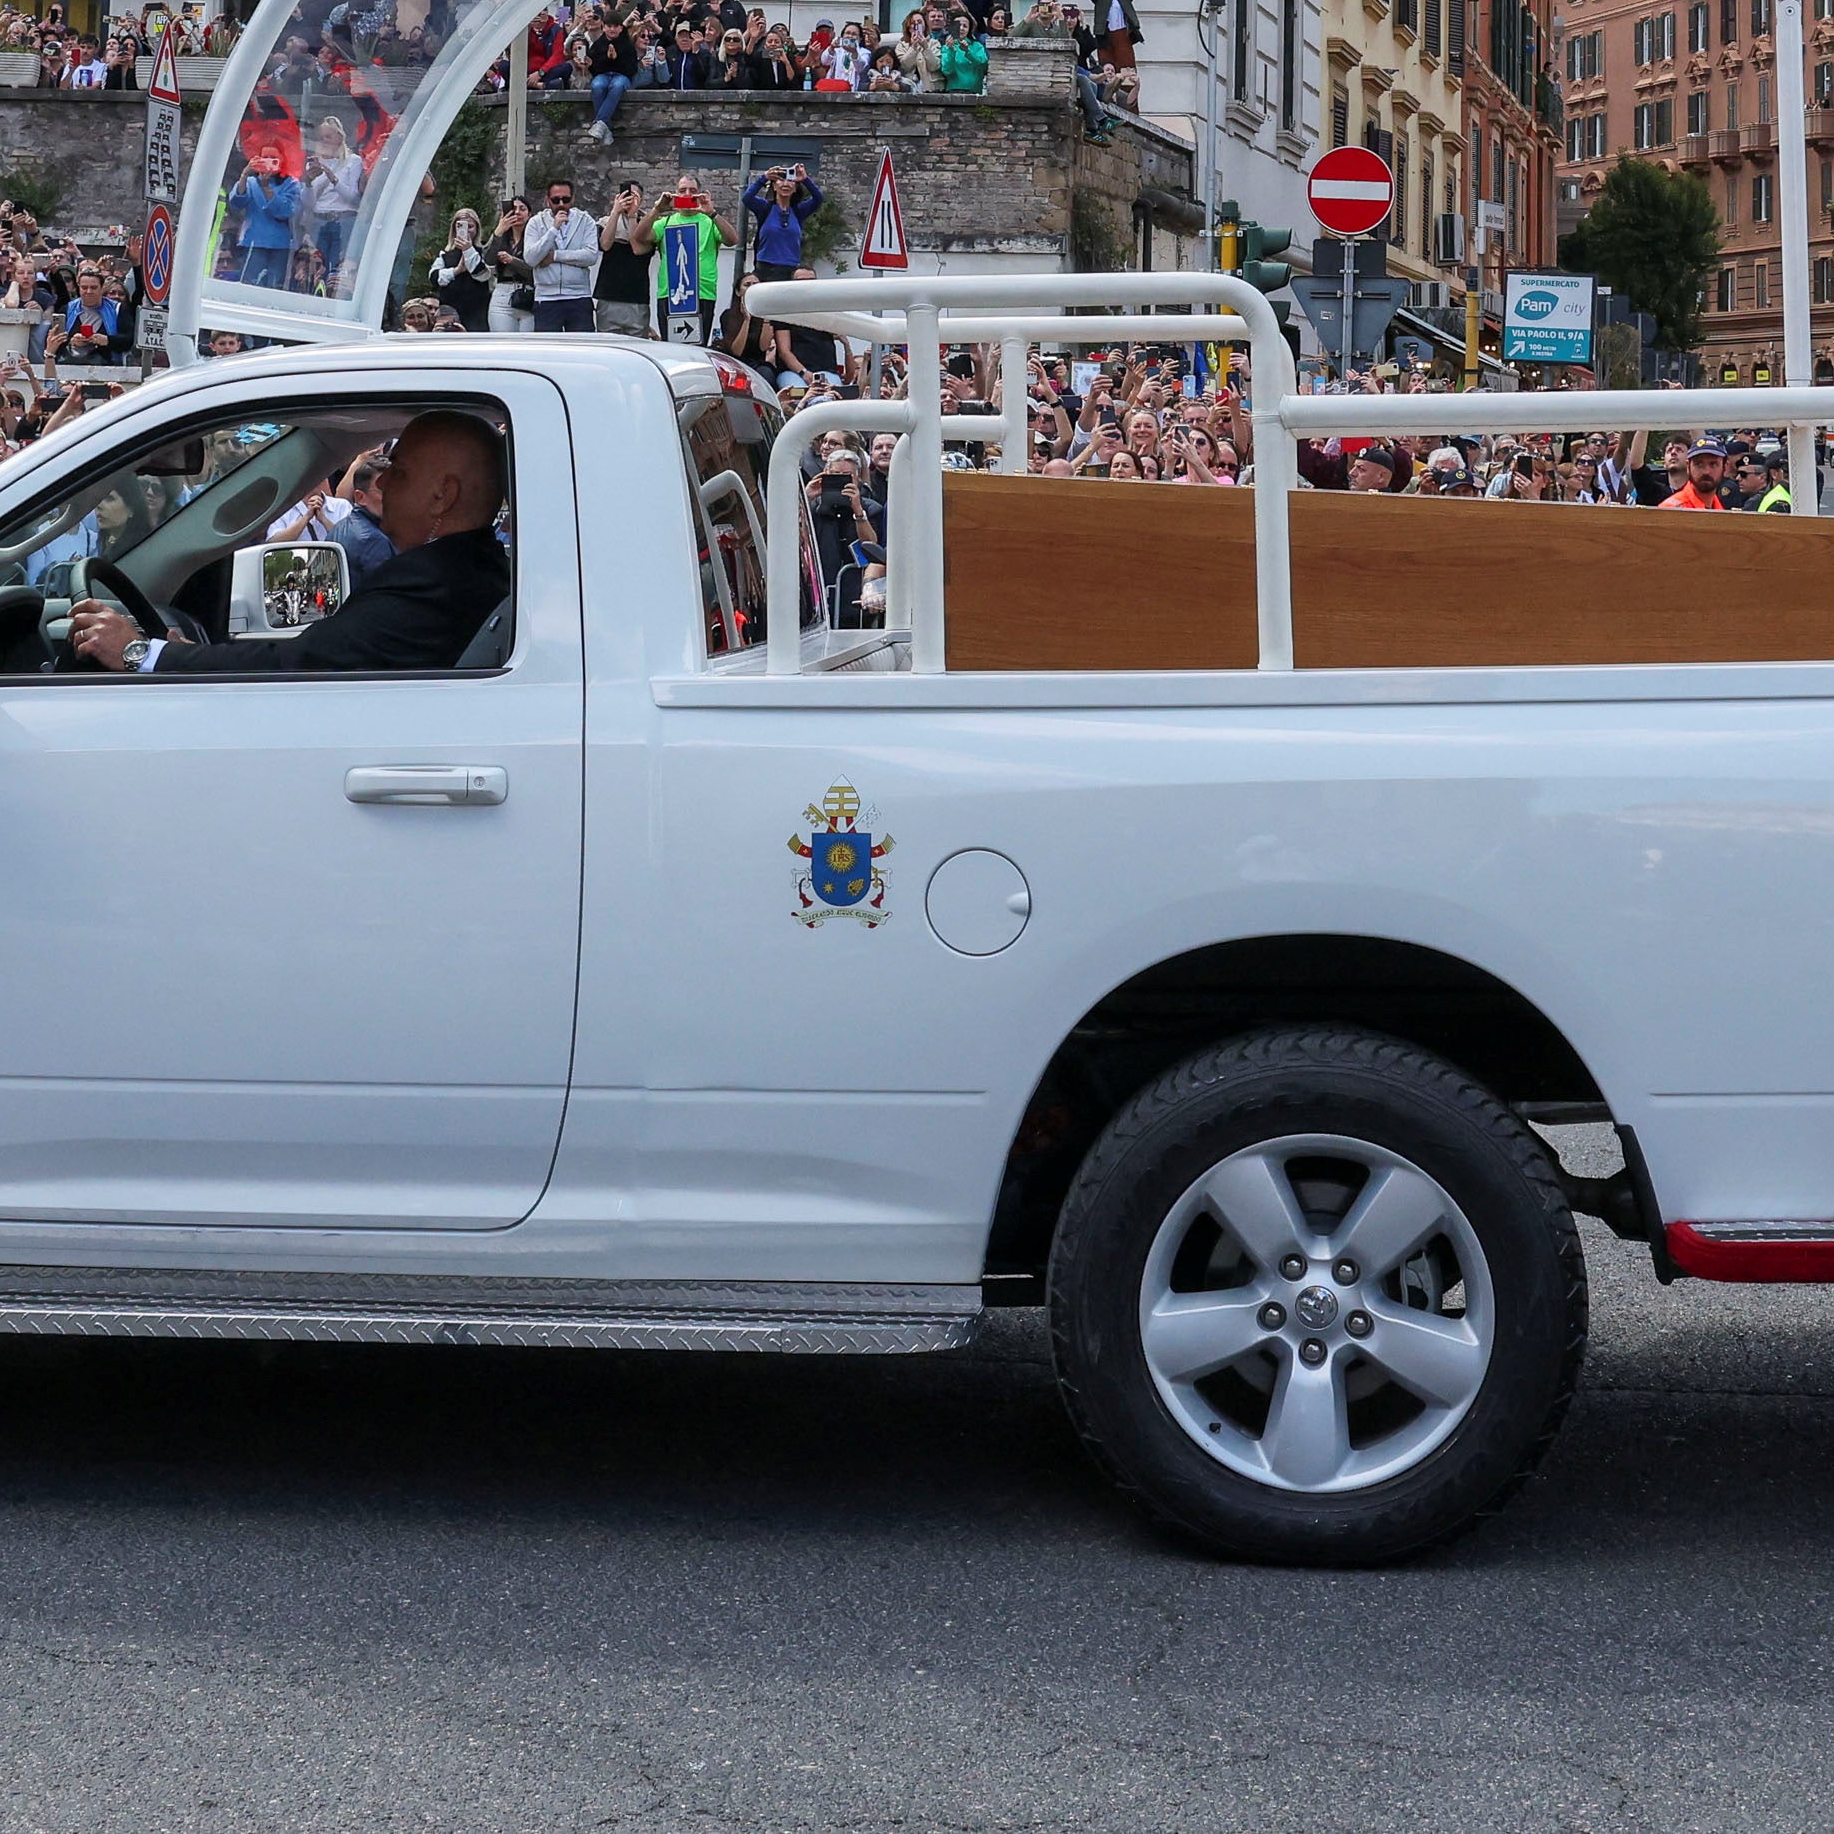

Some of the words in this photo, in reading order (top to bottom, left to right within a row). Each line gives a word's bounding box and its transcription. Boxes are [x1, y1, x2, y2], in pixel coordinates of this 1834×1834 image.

[1520, 278, 1580, 288] SUPERMERCATO
[1521, 297, 1552, 312] Pam
[1563, 302, 1586, 317] city
[1511, 329, 1526, 338] VIA
[1527, 330, 1555, 339] PAOLO
[1567, 331, 1585, 341] 9/A
[1529, 343, 1542, 351] 100
